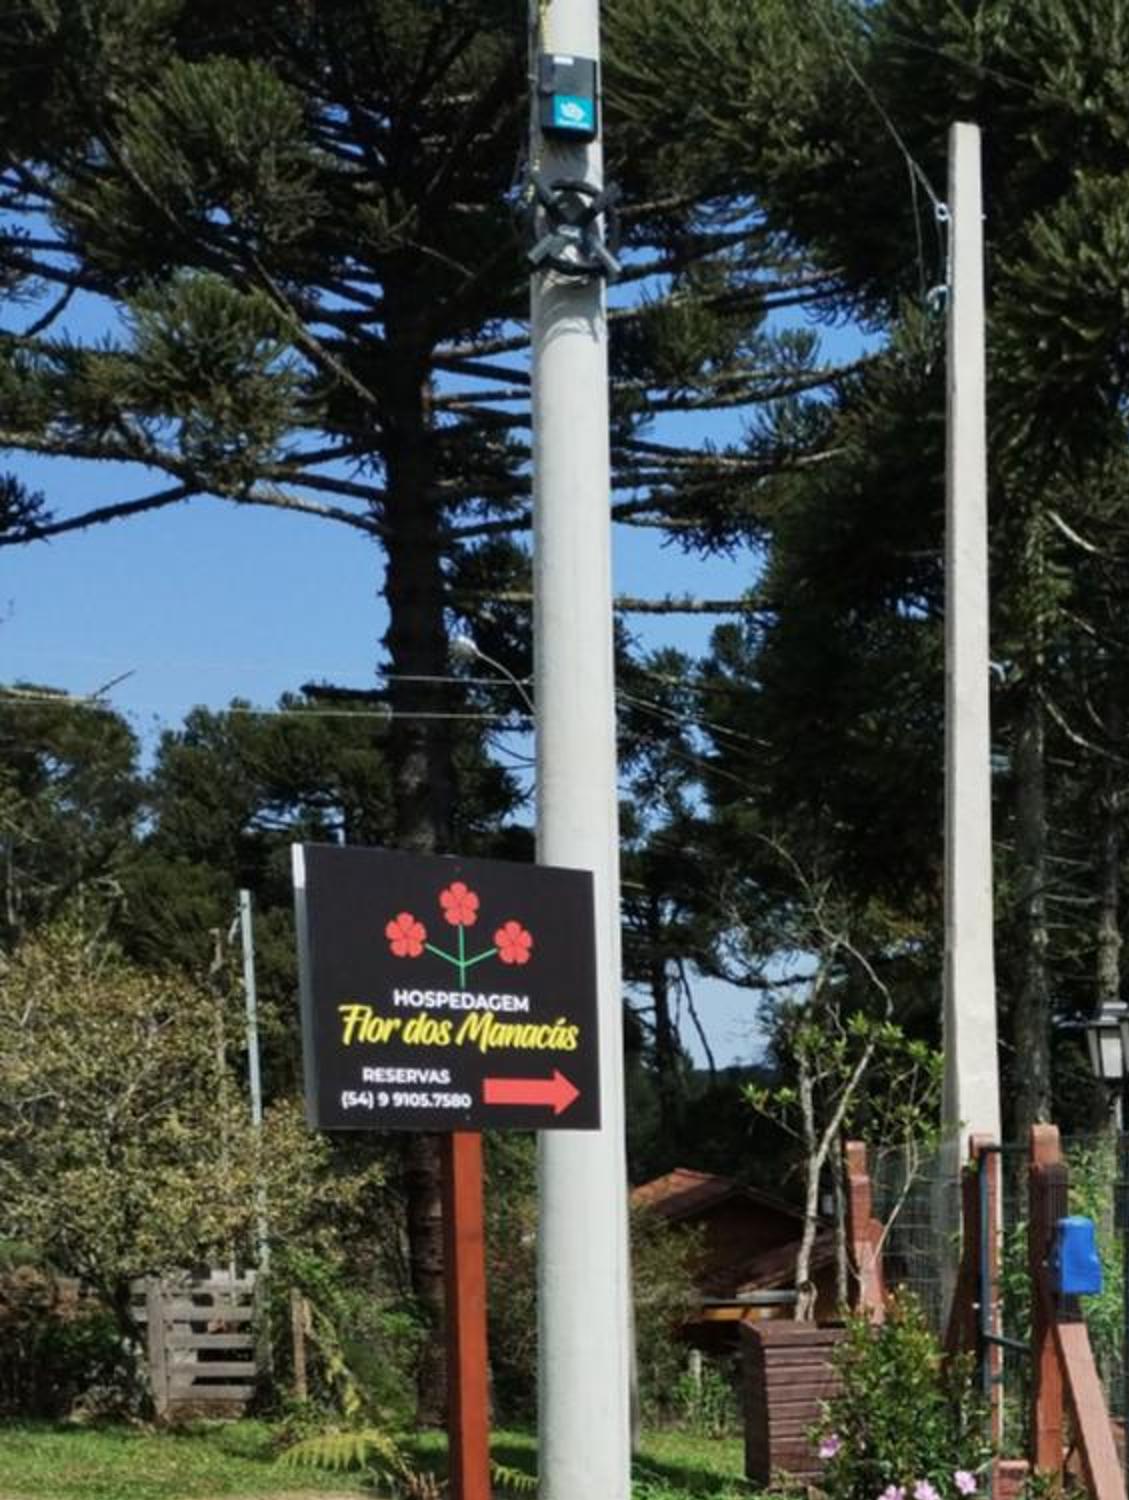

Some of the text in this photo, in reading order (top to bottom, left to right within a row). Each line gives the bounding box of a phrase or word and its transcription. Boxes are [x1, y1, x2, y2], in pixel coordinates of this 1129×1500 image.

[393, 989, 529, 1012] HOSPEDAGEM
[338, 1004, 579, 1053] Flor dos Manacás
[362, 1067, 451, 1084] RESERVAS
[341, 1091, 374, 1109] (54)
[378, 1091, 389, 1107] 9
